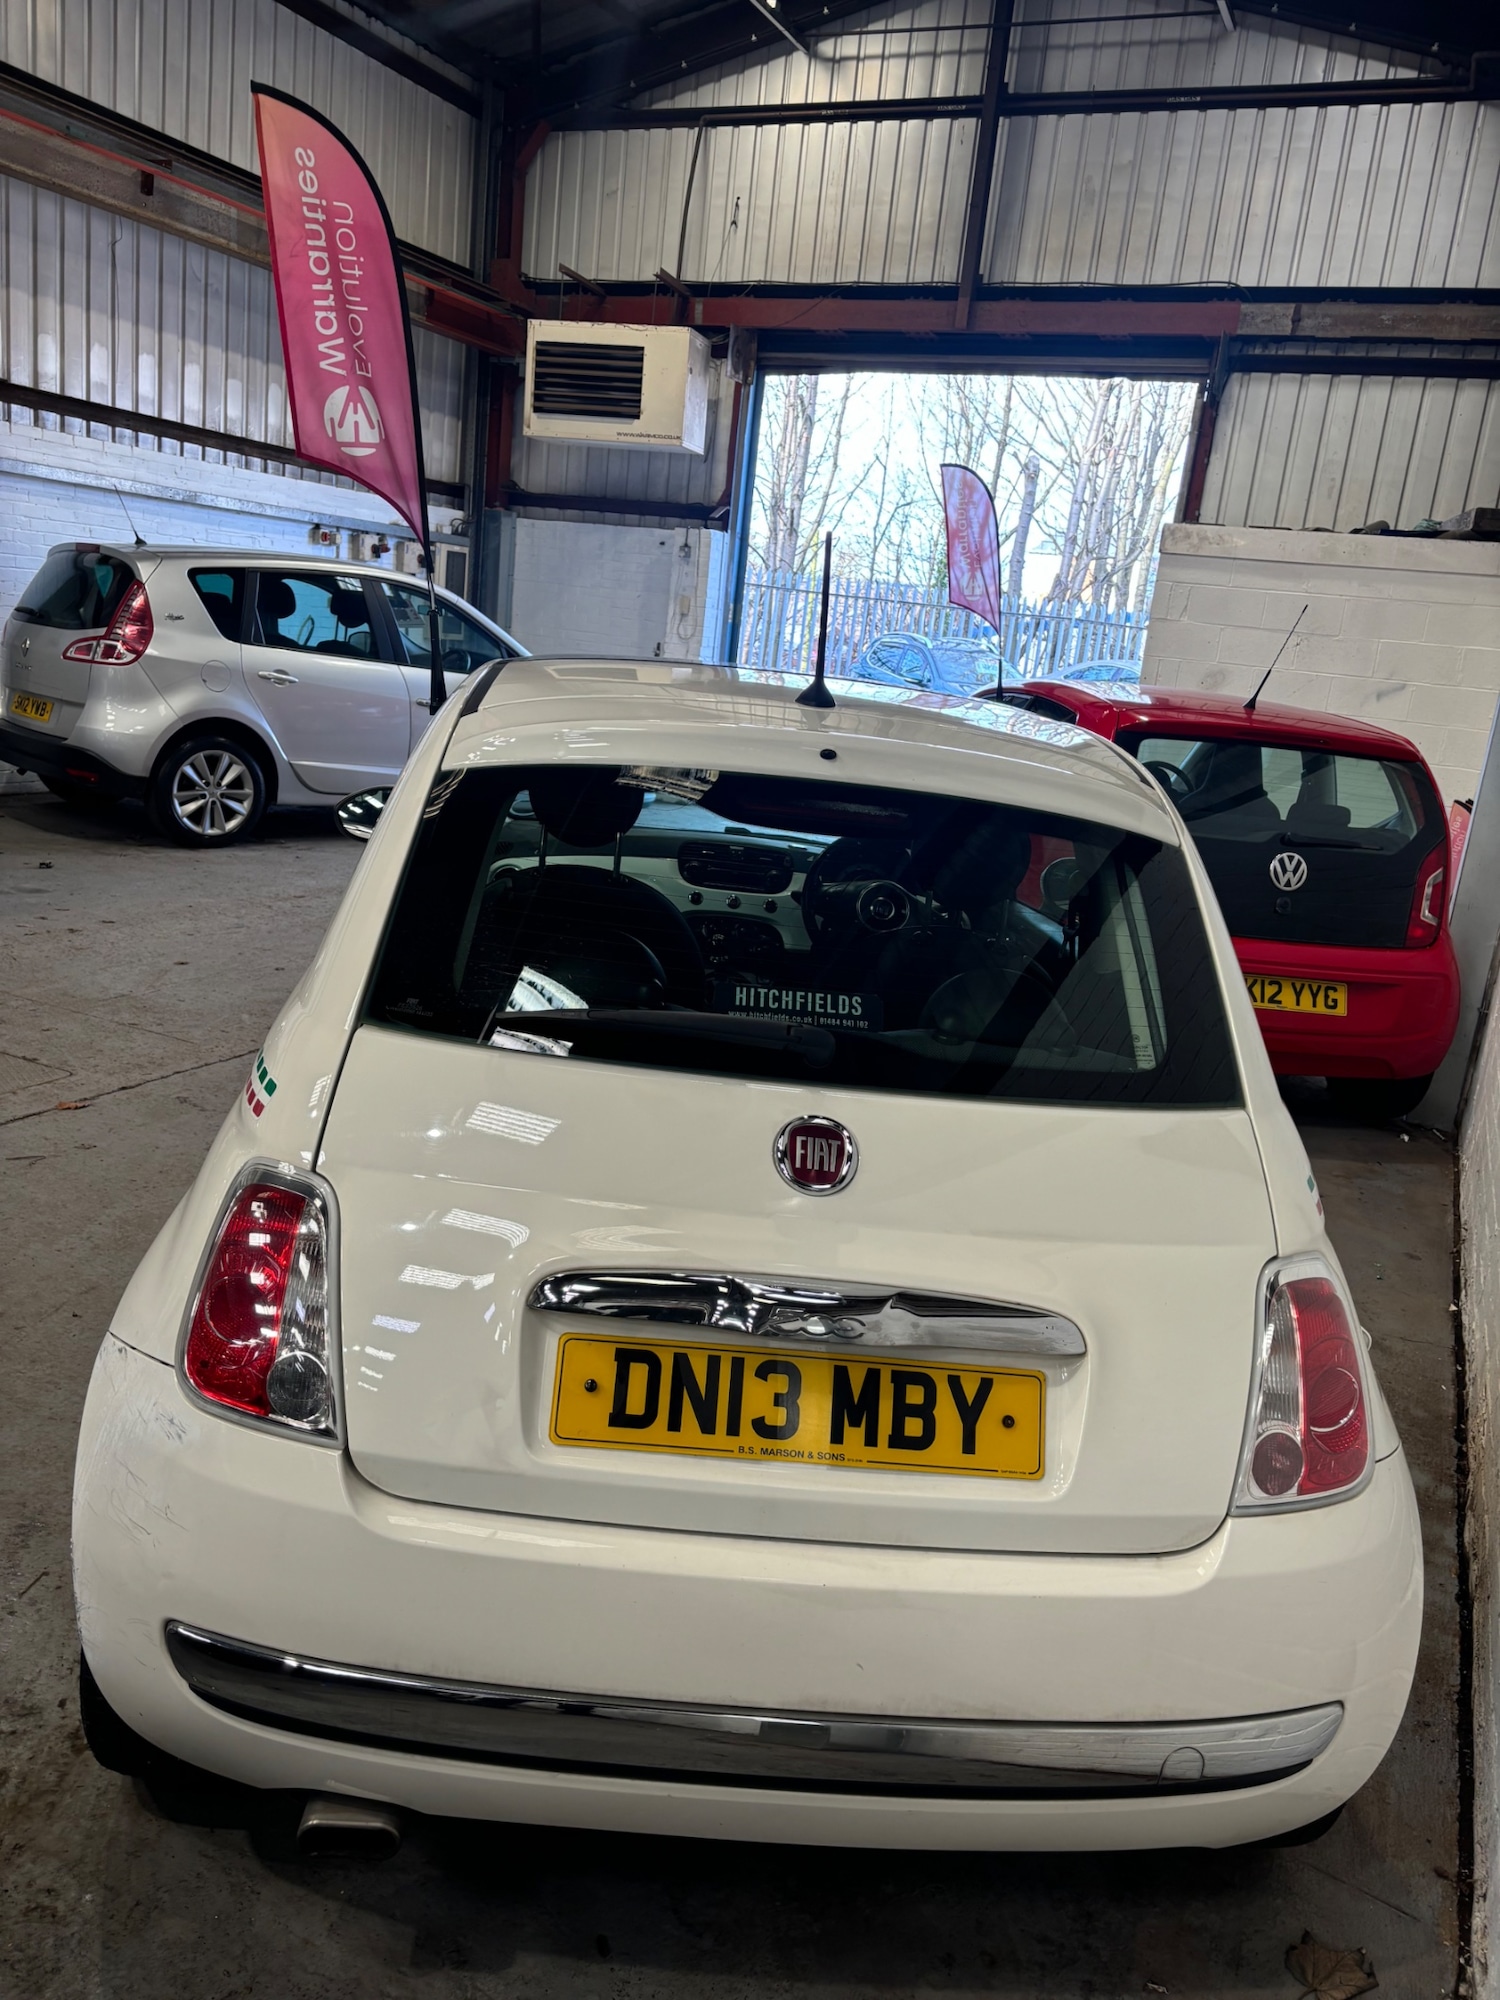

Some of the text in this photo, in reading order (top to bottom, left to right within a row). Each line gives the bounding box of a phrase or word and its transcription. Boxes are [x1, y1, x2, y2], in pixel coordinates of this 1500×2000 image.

[735, 986, 862, 1016] HITCHFIELDS
[1290, 982, 1338, 1010] YYG
[795, 1136, 842, 1173] FIAT
[607, 1347, 994, 1455] DN13 MBY
[738, 1446, 757, 1455] B.S.
[760, 1447, 805, 1459] MARSON
[807, 1451, 814, 1460] &
[817, 1452, 846, 1461] SONS
